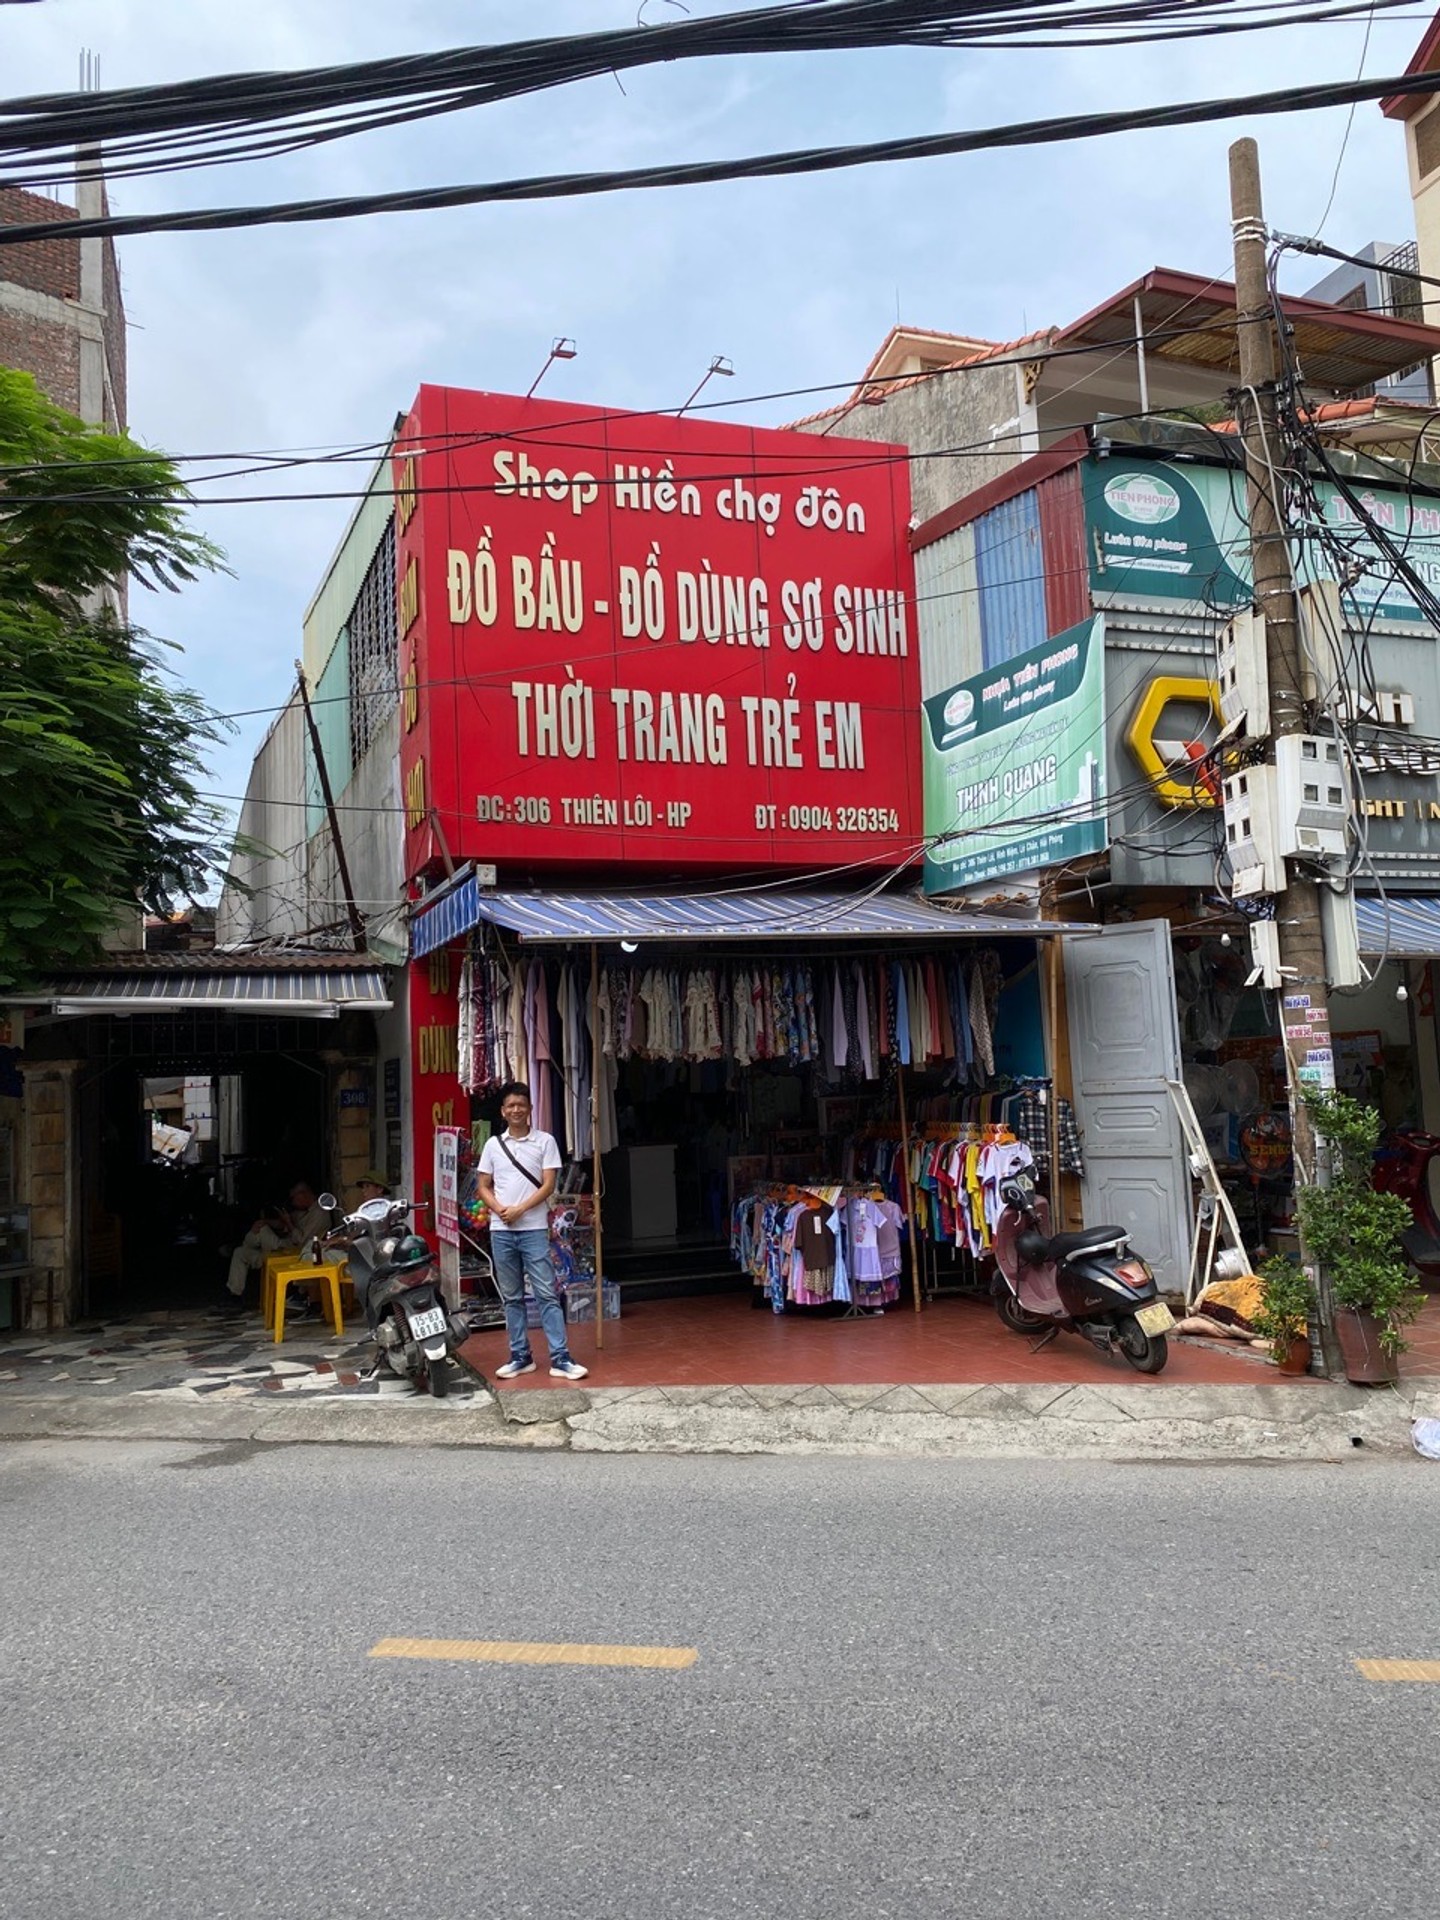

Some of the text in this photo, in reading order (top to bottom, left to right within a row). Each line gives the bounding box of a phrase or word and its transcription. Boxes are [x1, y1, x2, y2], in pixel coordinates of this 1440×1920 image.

[493, 450, 866, 537] Shop Hiền chợ đôn
[446, 525, 498, 627] ĐỒ
[511, 531, 584, 633] BẦU
[618, 541, 666, 641] ĐỒ
[676, 558, 770, 648] DÙNG
[781, 577, 824, 651] SƠ
[833, 584, 908, 657] SINH
[1012, 662, 1039, 688] TIỀN
[1040, 643, 1079, 675] PHONG
[511, 664, 866, 770] THỜI TRANG TRẺ EM
[477, 795, 551, 824] ĐC:306
[560, 793, 618, 825] THIÊN
[623, 794, 653, 826] LÔI
[667, 801, 692, 828] HP
[956, 775, 999, 815] THỊNH
[1003, 753, 1057, 802] QUANG
[835, 806, 900, 833] 326354
